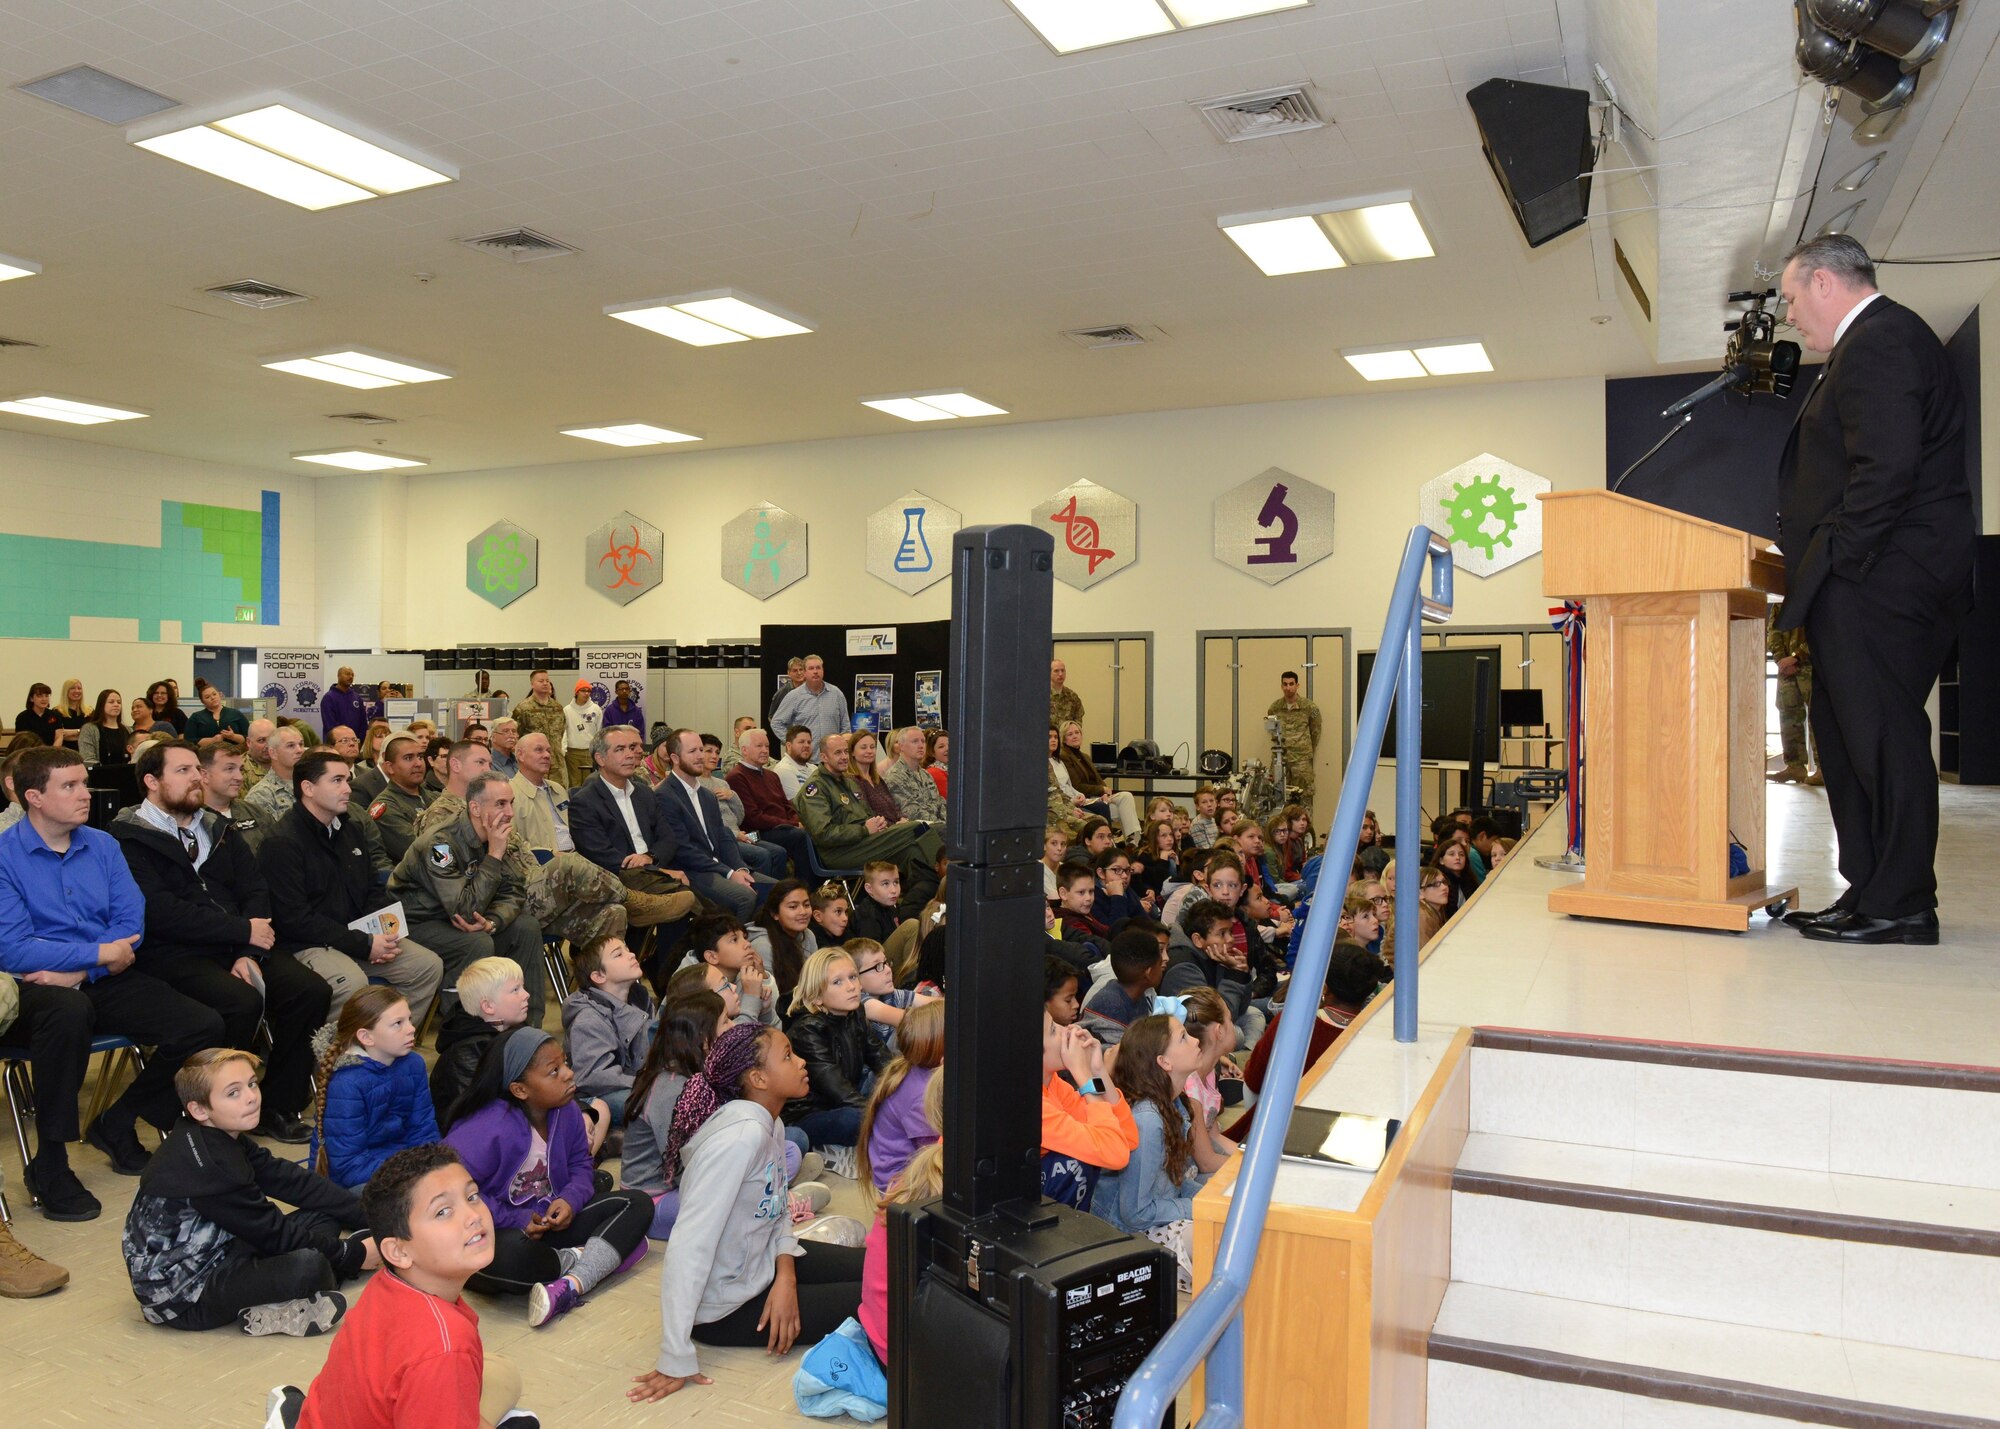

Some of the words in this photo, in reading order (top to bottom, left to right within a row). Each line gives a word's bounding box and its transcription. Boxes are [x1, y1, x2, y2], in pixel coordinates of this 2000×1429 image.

[238, 609, 254, 621] EXIT
[292, 681, 321, 693] SCORPION
[1117, 1265, 1151, 1283] BEACON
